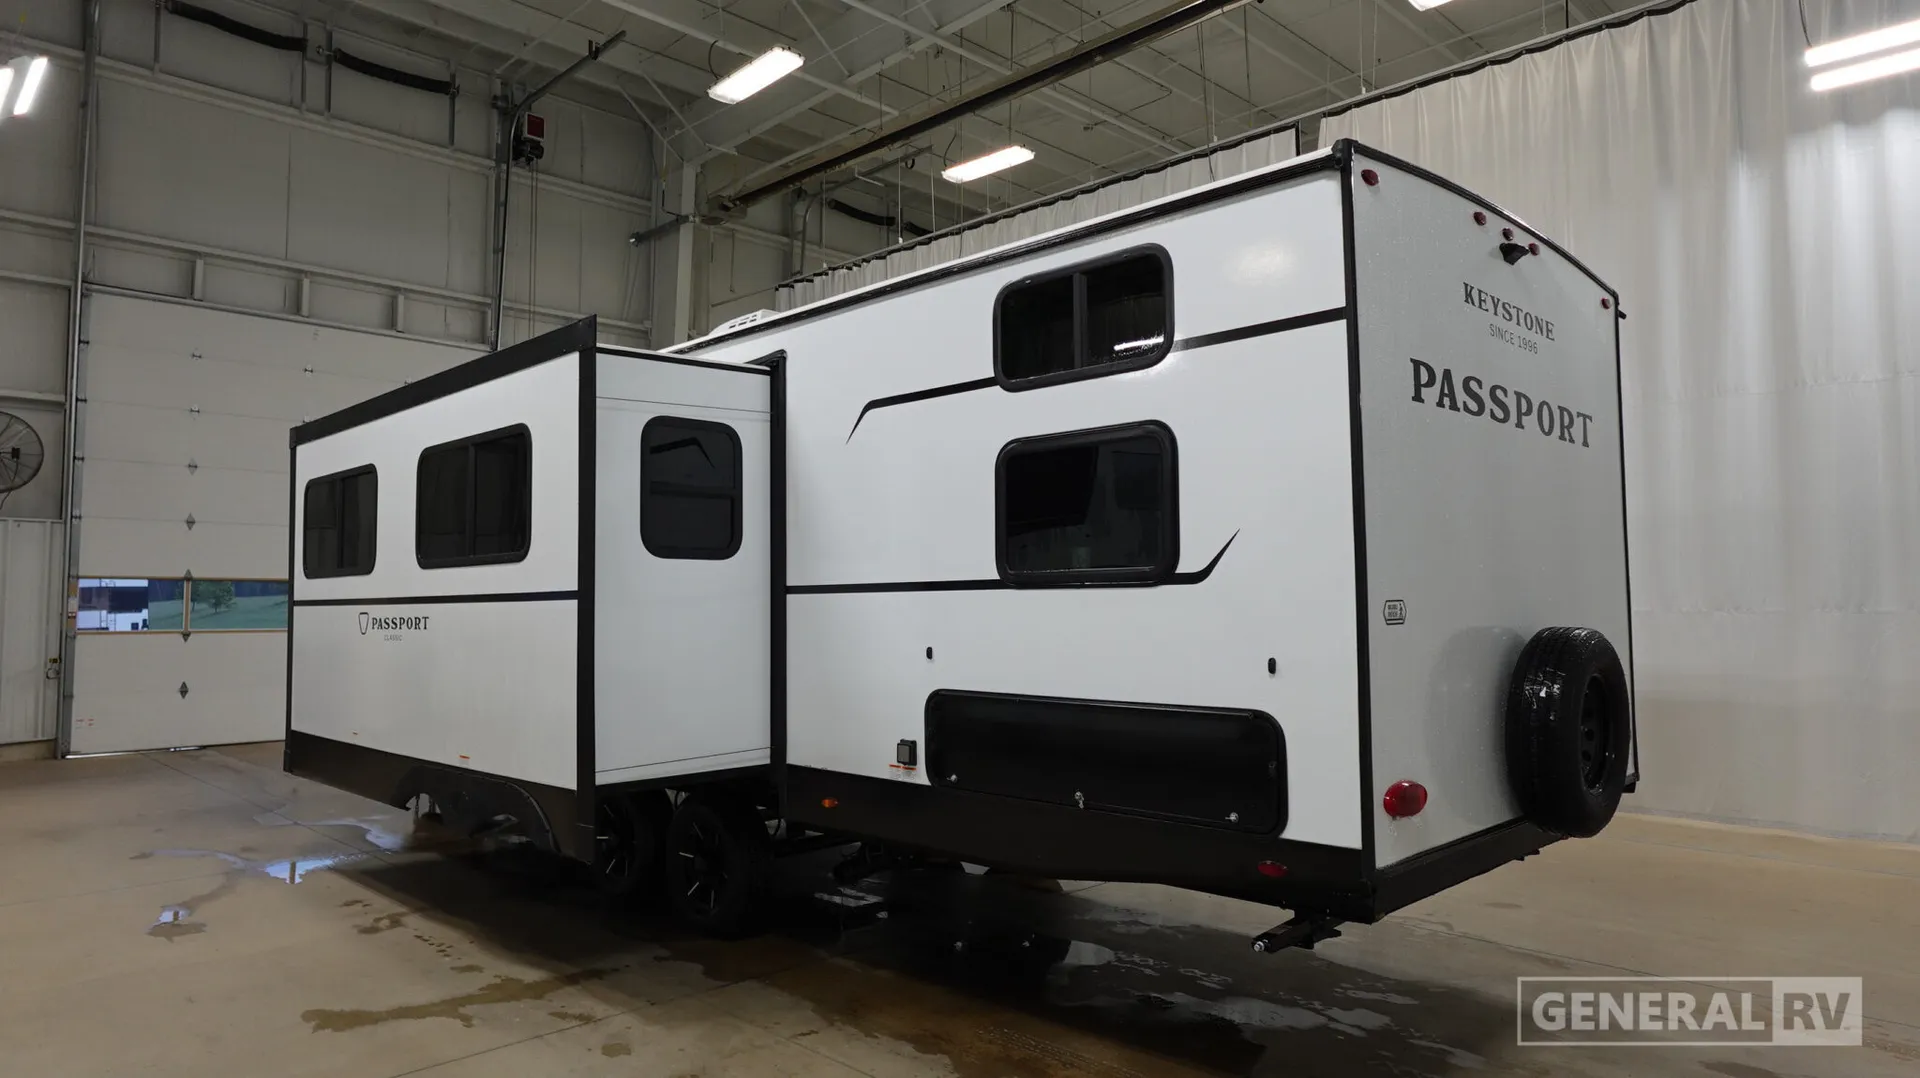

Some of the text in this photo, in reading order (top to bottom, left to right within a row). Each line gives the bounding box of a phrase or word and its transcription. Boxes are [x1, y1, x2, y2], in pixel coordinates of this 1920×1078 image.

[1463, 282, 1555, 341] KEYSTONE
[1489, 323, 1538, 354] SINCE 1996
[1410, 357, 1593, 448] PASSPORT
[371, 616, 430, 630] PASSPORT
